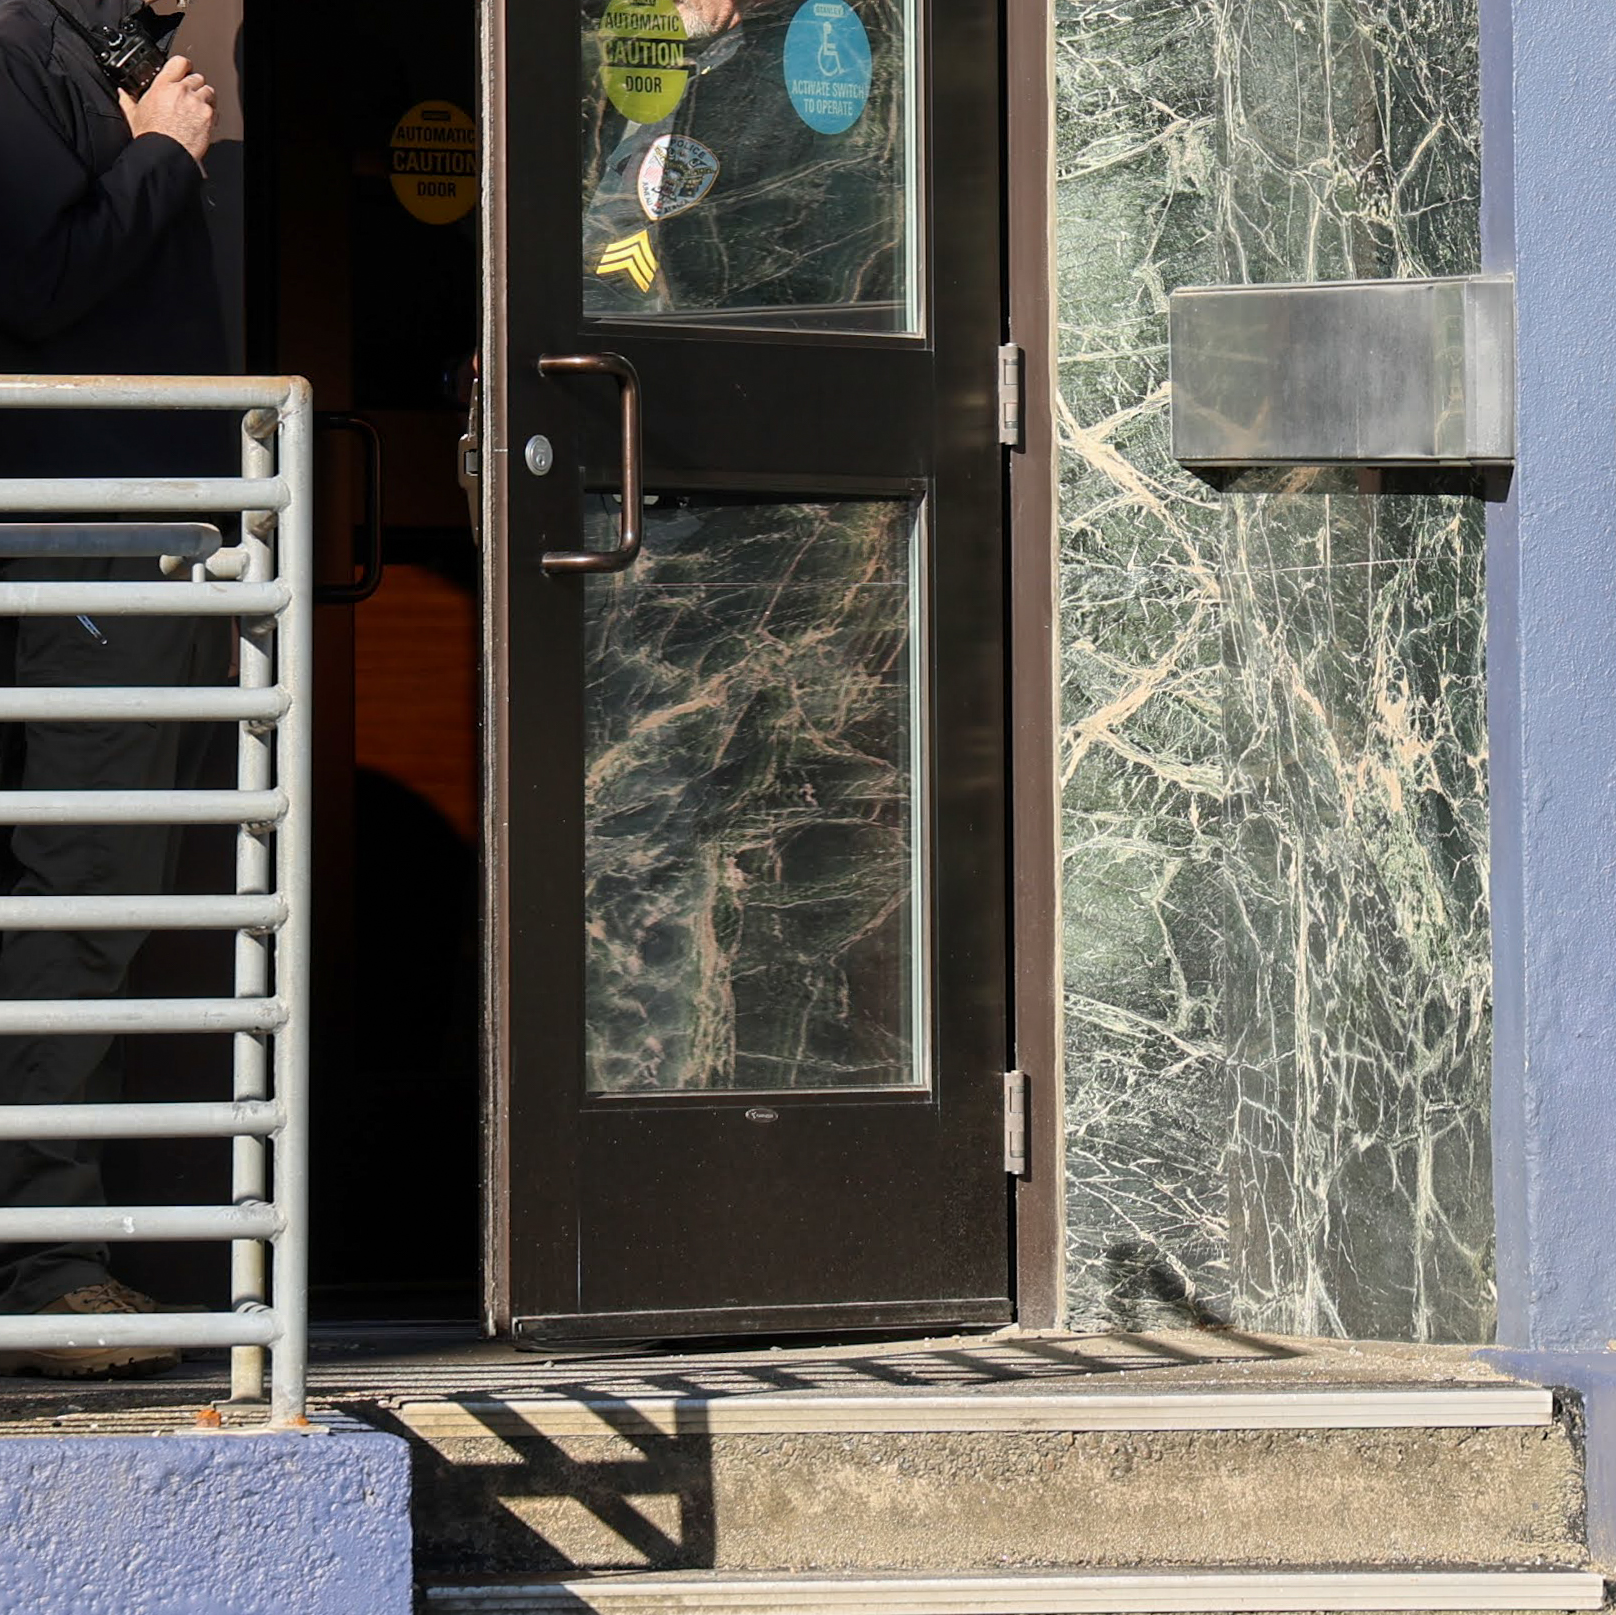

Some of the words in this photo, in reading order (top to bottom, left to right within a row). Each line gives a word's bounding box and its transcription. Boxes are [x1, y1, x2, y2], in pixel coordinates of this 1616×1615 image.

[605, 12, 680, 32] AUTOMATIC
[603, 40, 684, 66] CAUTION
[626, 76, 662, 93] DOOR
[791, 80, 831, 97] ACTIVATE
[832, 82, 865, 99] SWITCH
[804, 98, 814, 113] TO
[816, 99, 854, 116] OPERATE
[396, 126, 476, 144] AUTOMATIC
[670, 138, 706, 160] POLICE
[392, 149, 476, 174] CAUTION
[417, 181, 457, 198] DOOR
